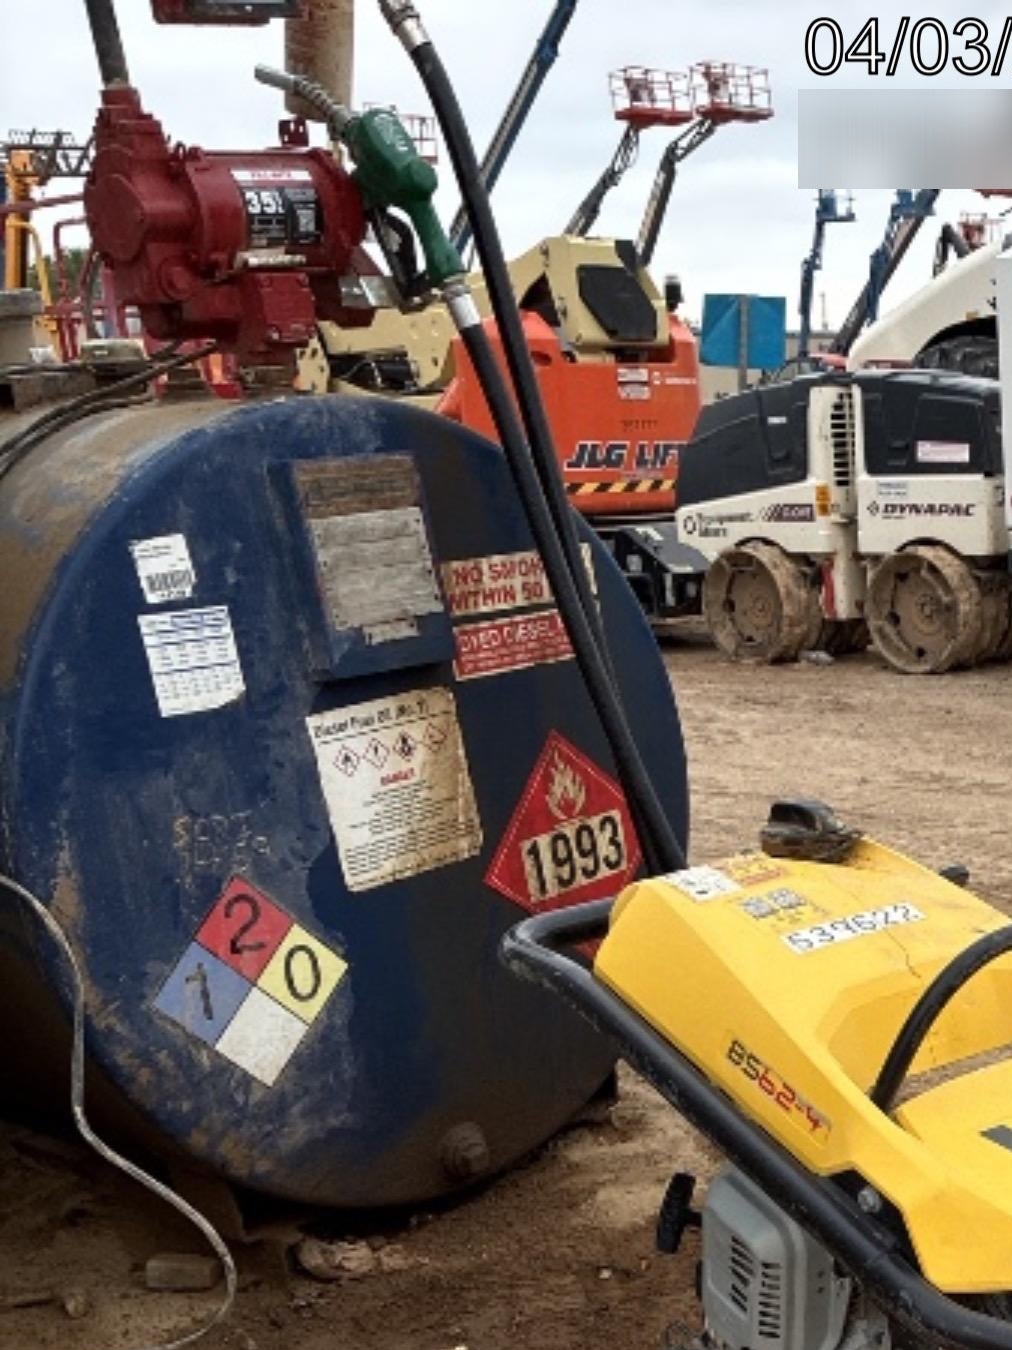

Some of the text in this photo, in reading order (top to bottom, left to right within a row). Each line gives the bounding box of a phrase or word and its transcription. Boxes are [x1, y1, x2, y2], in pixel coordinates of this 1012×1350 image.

[564, 441, 630, 471] JLG
[881, 503, 976, 517] DYNAPAC
[453, 563, 484, 585] NO
[449, 582, 544, 611] WITHIN 50
[526, 815, 624, 897] 1993
[224, 893, 268, 955] 2
[786, 904, 920, 951] 539622
[184, 944, 322, 1021] 1 0
